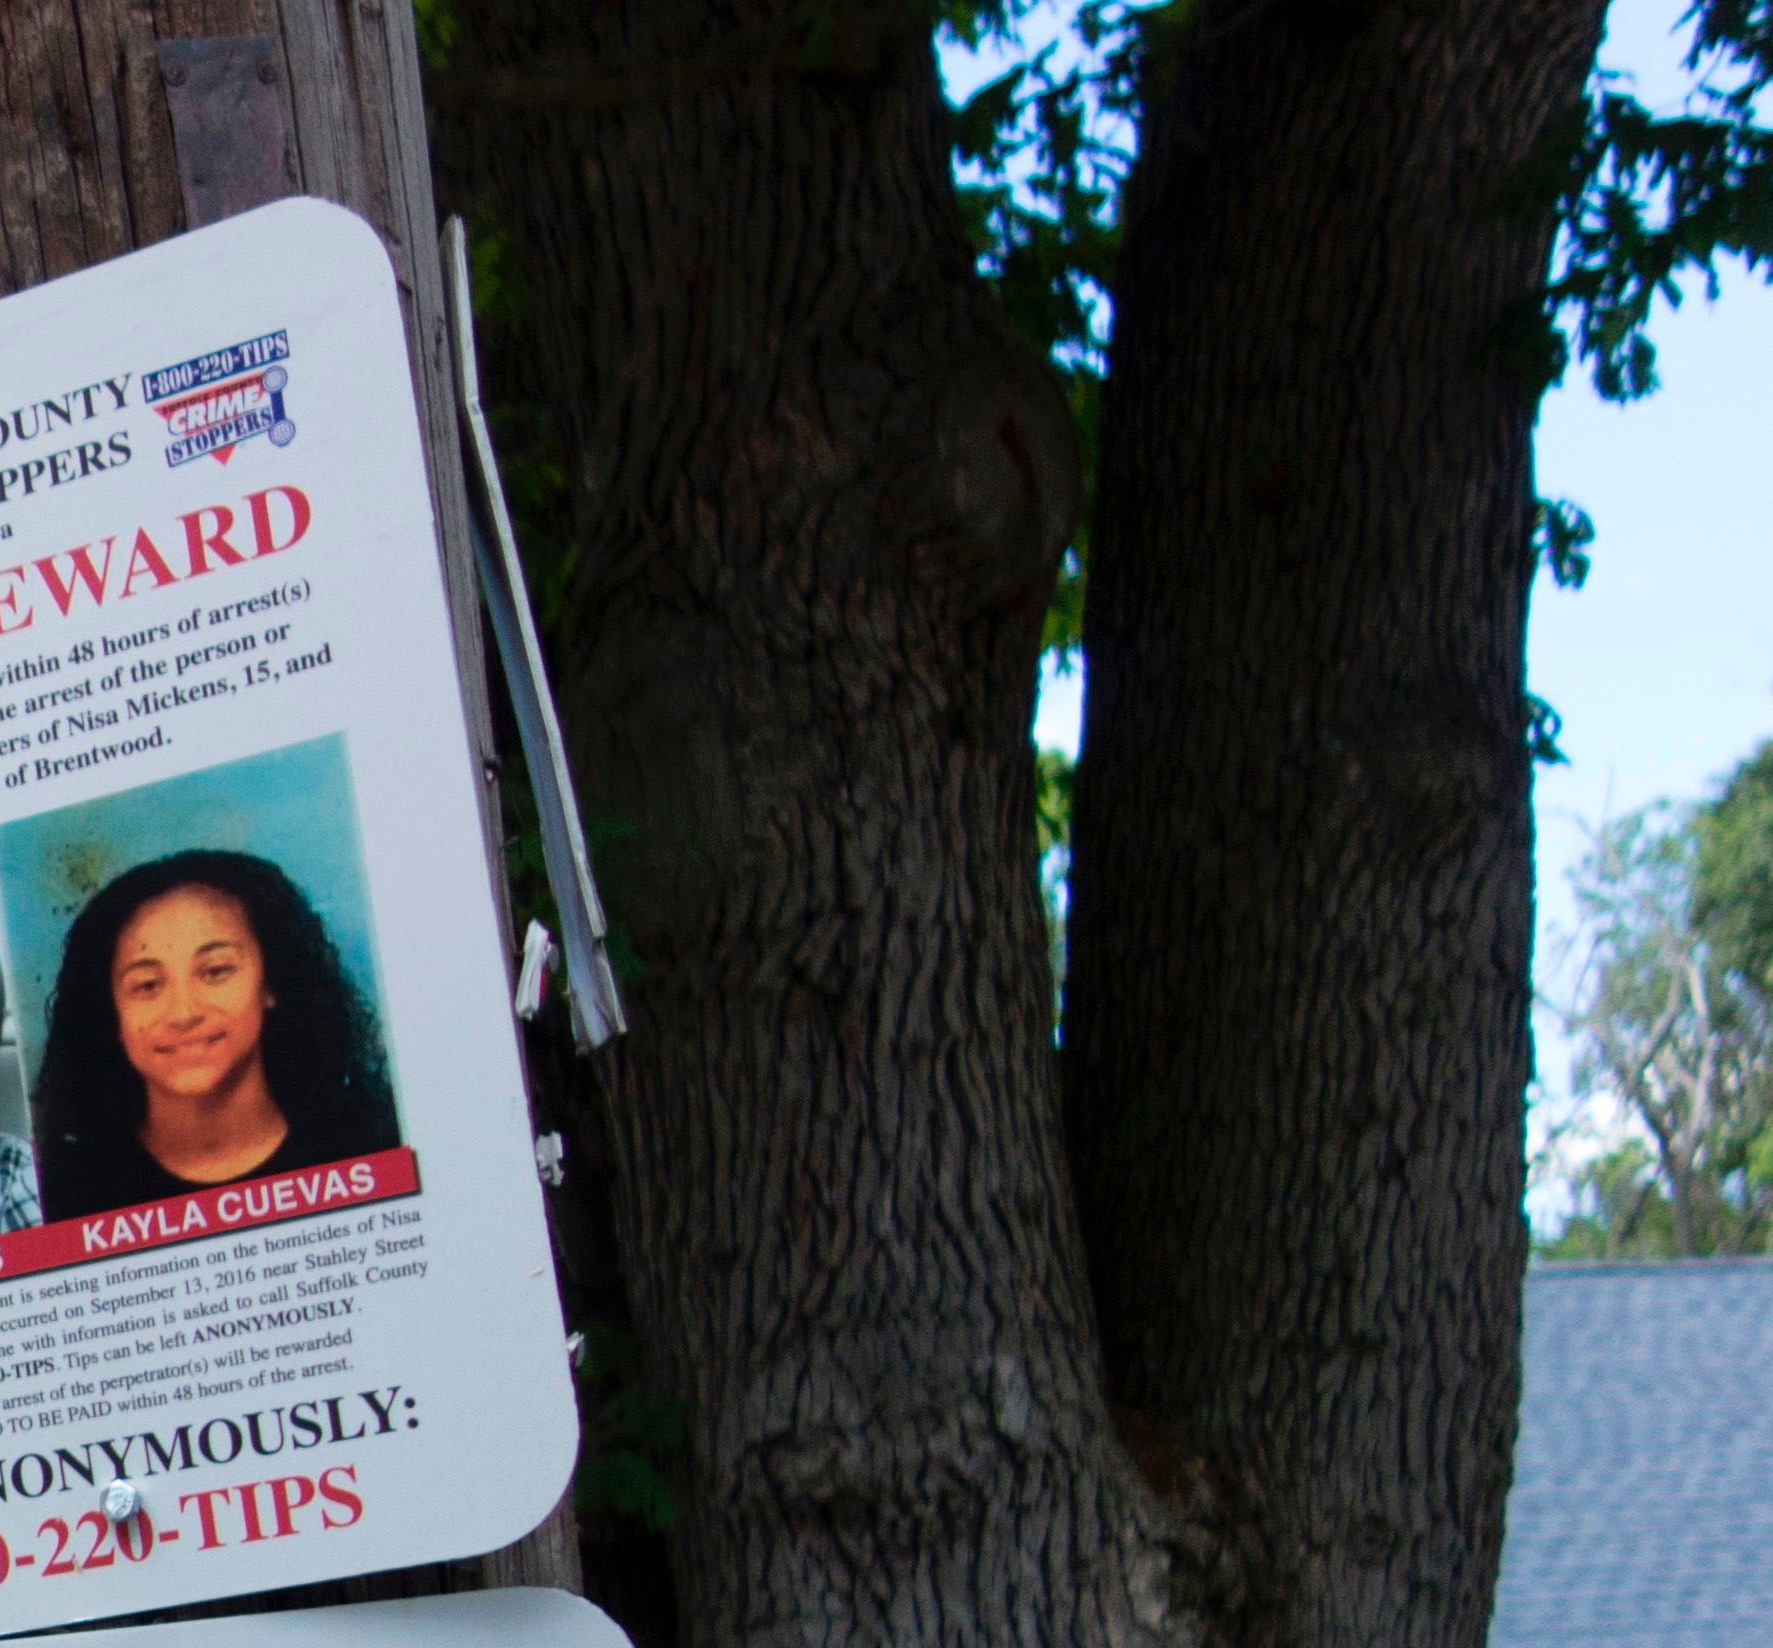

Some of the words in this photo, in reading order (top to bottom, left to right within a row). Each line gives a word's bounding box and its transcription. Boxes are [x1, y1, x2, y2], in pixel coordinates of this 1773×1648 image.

[144, 332, 289, 400] 1-800-220-TIPS
[167, 383, 262, 435] CRIME
[171, 408, 272, 462] STOPPERS
[0, 524, 13, 540] a
[68, 640, 95, 664] 48
[101, 623, 170, 656] hours
[177, 608, 201, 633] of
[208, 580, 310, 625] arrest(s)
[24, 678, 93, 714] arrest
[100, 666, 123, 691] of
[130, 660, 167, 683] the
[175, 634, 257, 676] person
[264, 623, 290, 644] or
[37, 719, 60, 744] of
[67, 709, 119, 736] Nisa
[126, 678, 237, 719] Mickens,
[245, 659, 280, 686] 15,
[286, 642, 332, 674] and
[5, 764, 28, 788] of
[34, 726, 172, 780] Brentwood.
[82, 1199, 207, 1252] KAYLA
[217, 1162, 375, 1223] CUEVAS
[20, 1288, 33, 1304] is
[39, 1277, 100, 1299] seeking
[105, 1256, 200, 1286] information
[206, 1251, 227, 1264] on
[233, 1243, 258, 1259] the
[264, 1224, 351, 1253] homicides
[357, 1215, 375, 1234] of
[381, 1209, 422, 1229] Nisa
[63, 1352, 98, 1370] Tips
[103, 1347, 131, 1361] can
[135, 1340, 154, 1354] be
[159, 1332, 186, 1350] left
[193, 1296, 361, 1343] ANONYMOUSLY.
